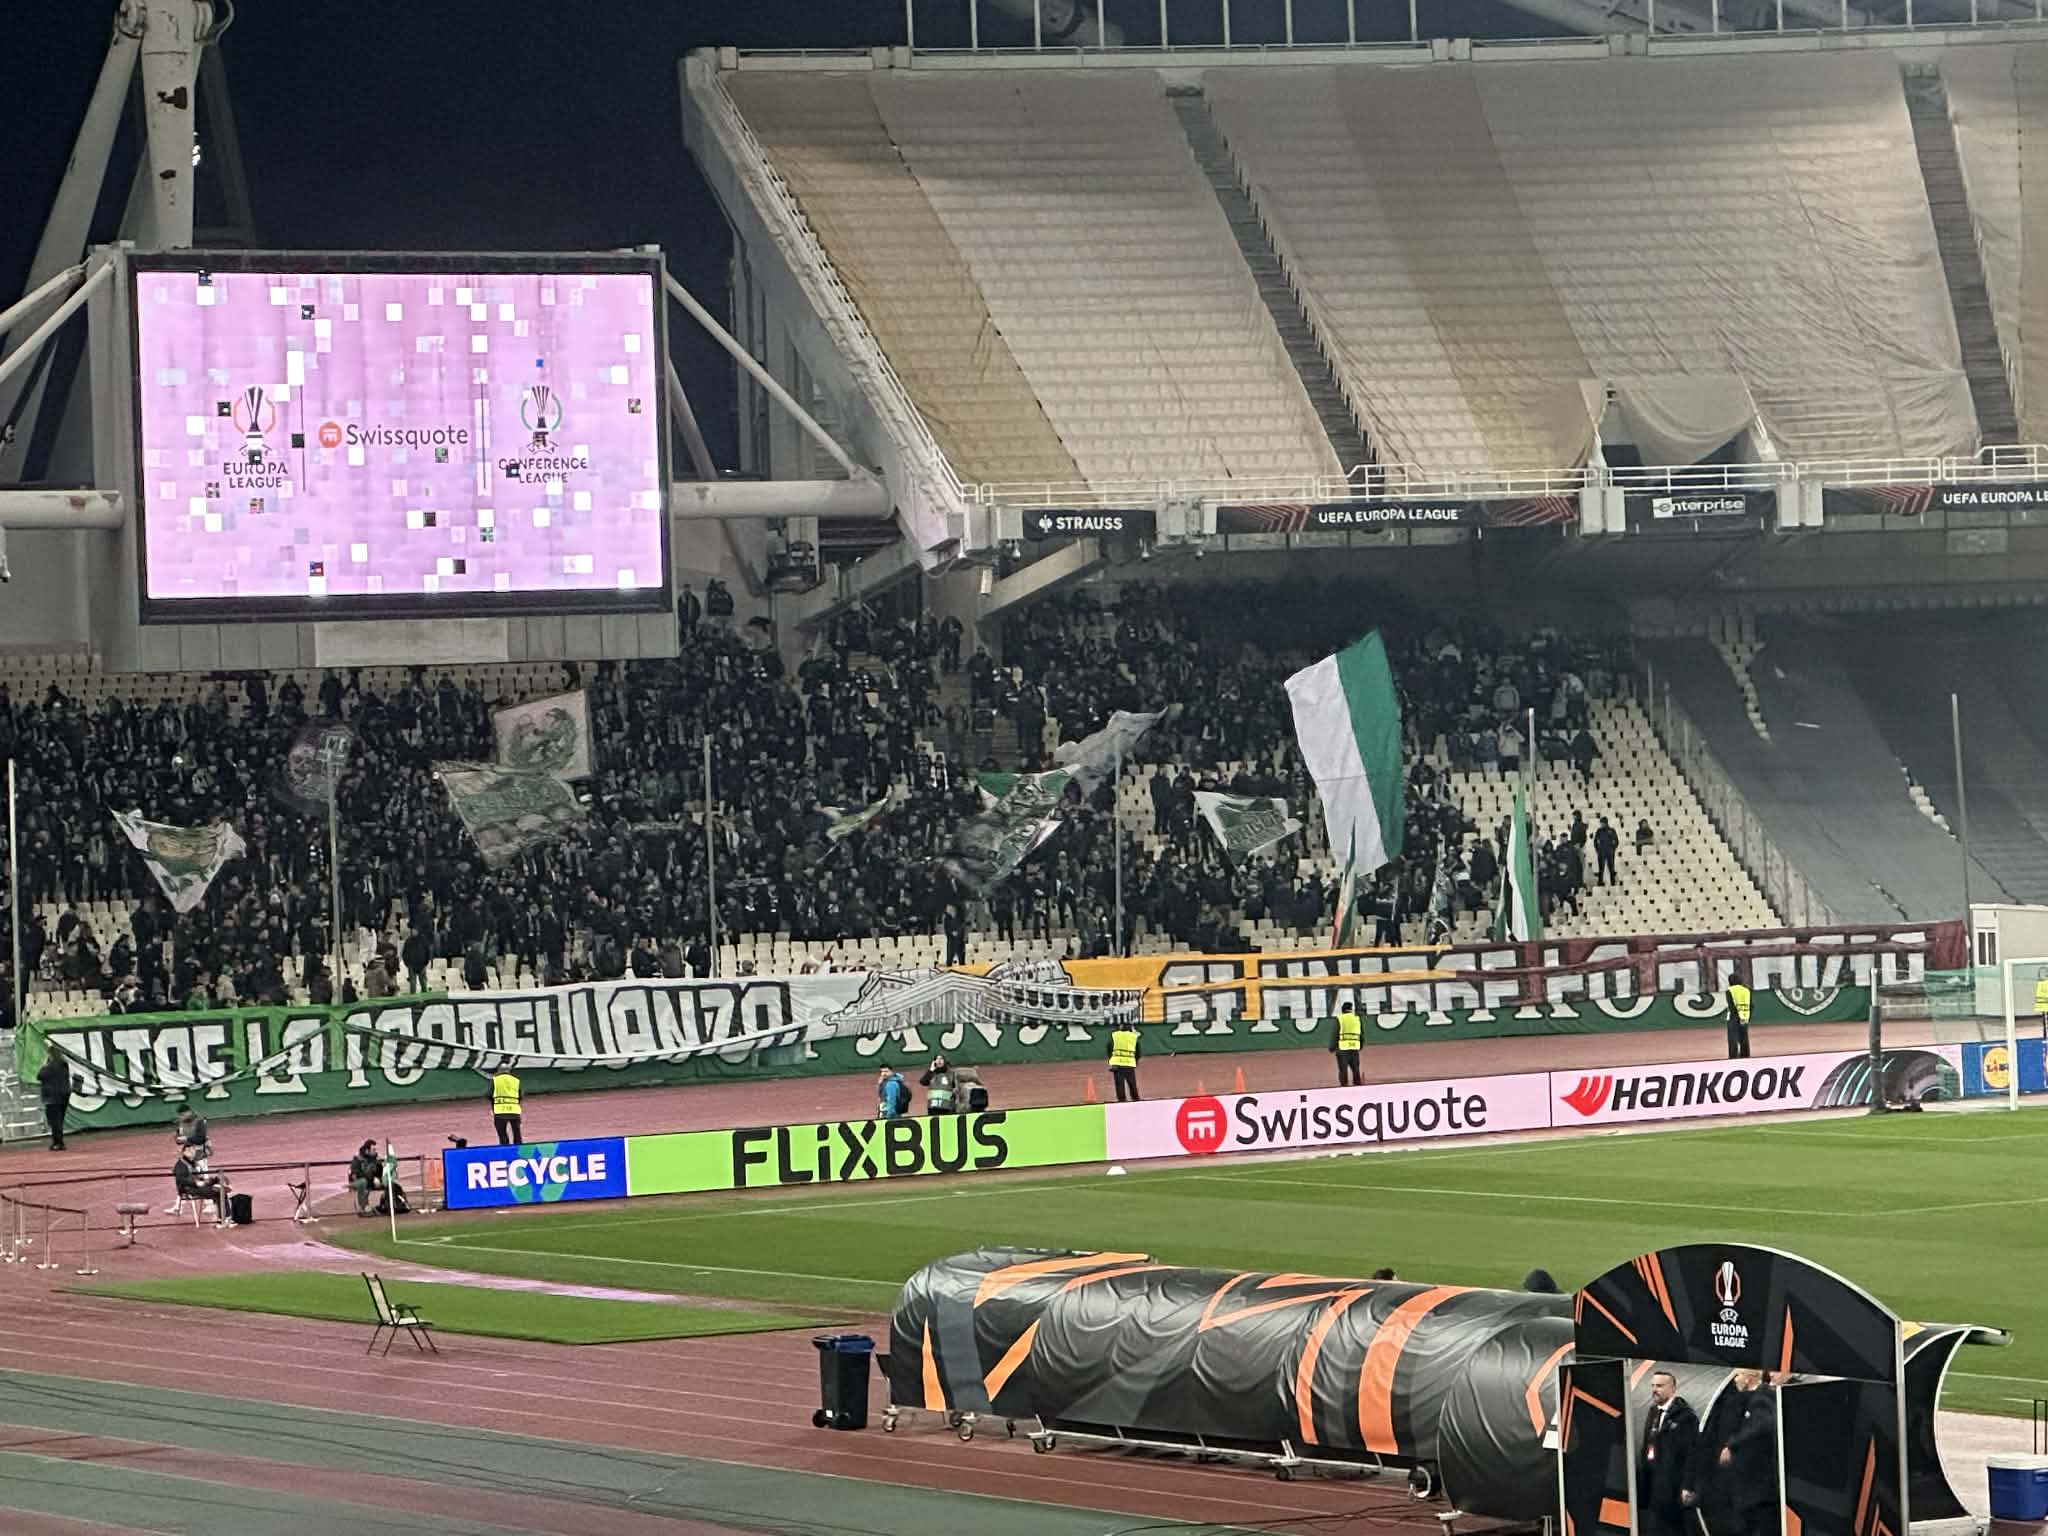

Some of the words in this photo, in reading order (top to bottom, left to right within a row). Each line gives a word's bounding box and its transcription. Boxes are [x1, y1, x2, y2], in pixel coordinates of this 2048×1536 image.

[346, 424, 468, 450] Swissquote
[223, 462, 288, 475] EUROPA
[229, 477, 283, 488] LEAGUE
[1943, 492, 1978, 504] UEFA
[1981, 491, 2033, 503] EUROPA
[1655, 498, 1744, 513] enterprise
[1056, 516, 1123, 530] STRAUSS
[1318, 511, 1353, 524] UEFA
[1355, 509, 1407, 522] EUROPA
[1408, 509, 1459, 520] LEAGUE
[1235, 1087, 1488, 1145] Swissquote
[467, 1153, 607, 1189] RECYCLE
[1711, 1322, 1749, 1337] EUROPA
[1714, 1335, 1747, 1348] LEAGUE
